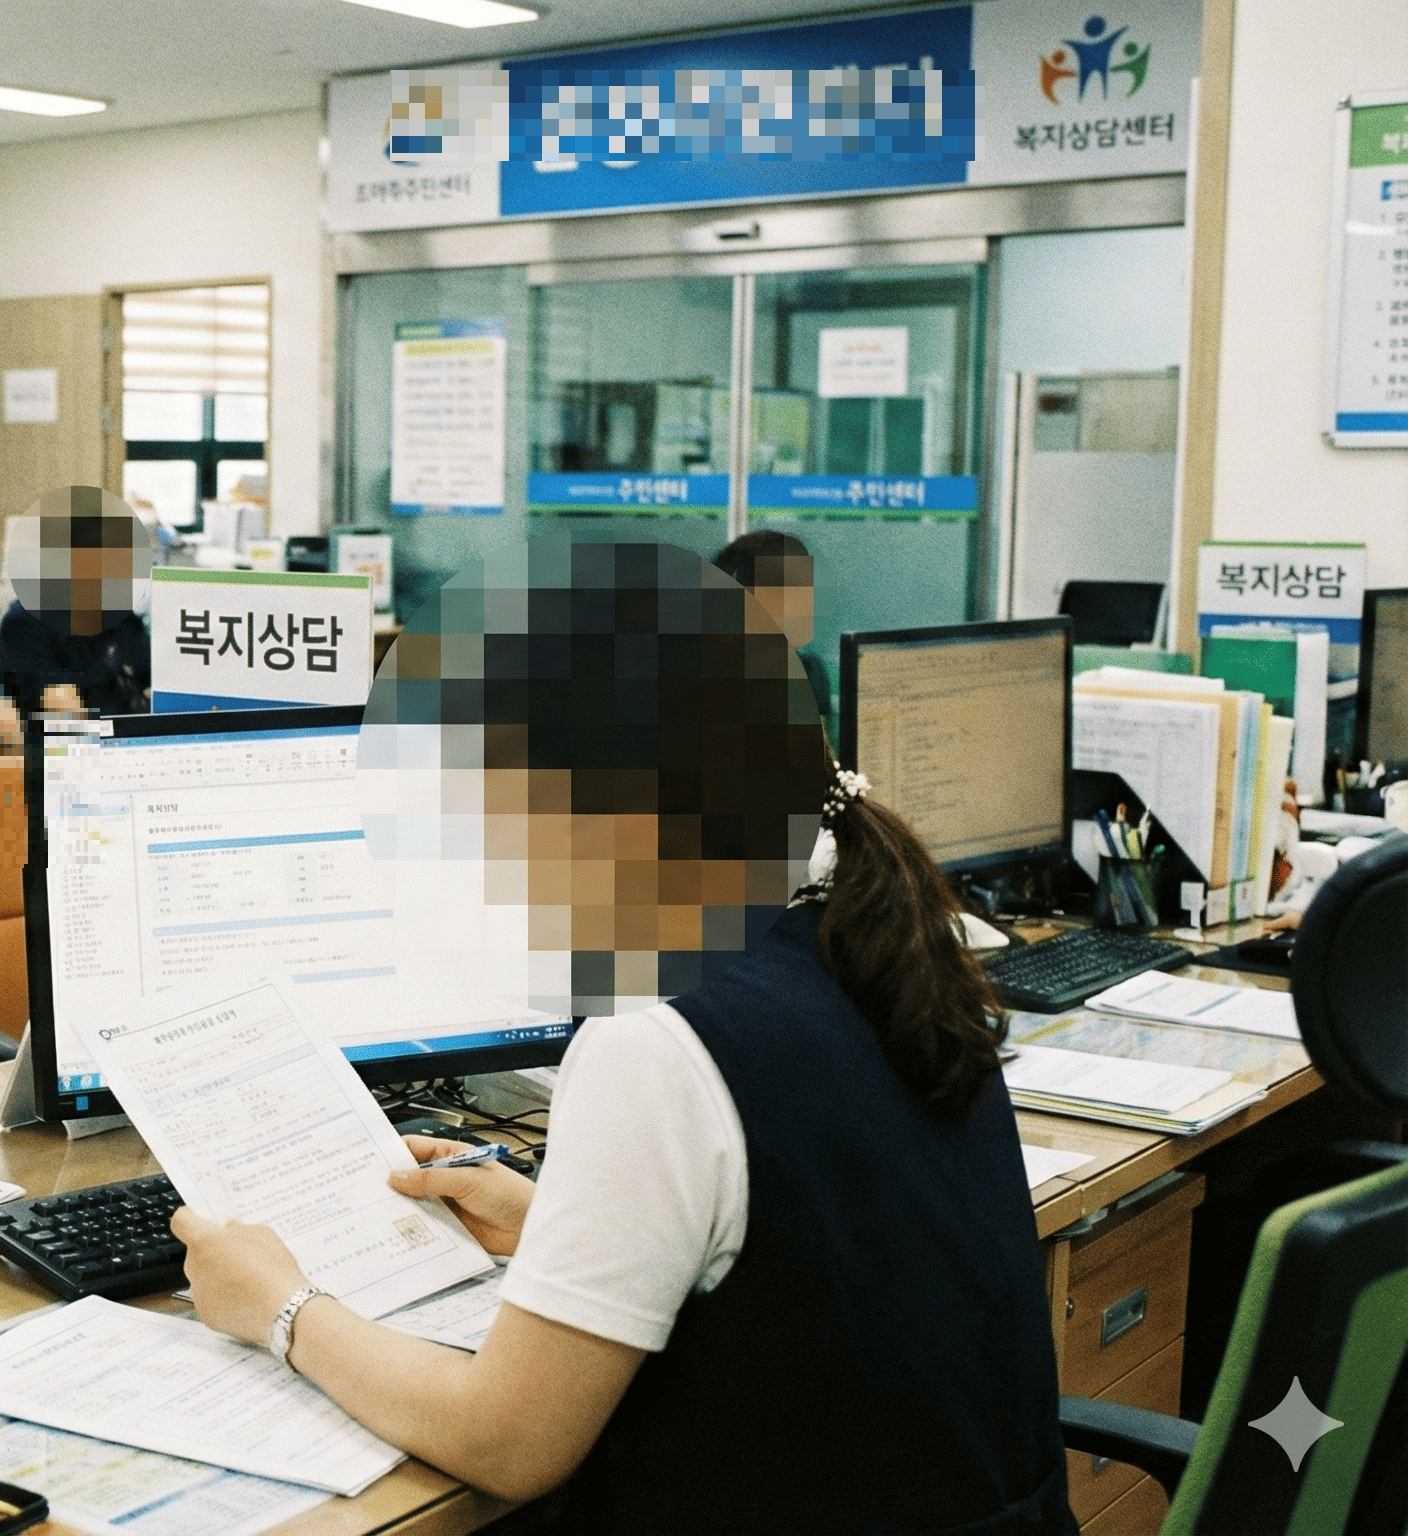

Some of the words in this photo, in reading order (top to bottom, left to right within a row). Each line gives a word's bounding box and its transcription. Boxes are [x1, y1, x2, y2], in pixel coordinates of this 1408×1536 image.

[1014, 112, 1175, 152] 복지상담센터
[1217, 563, 1346, 599] 복지상담
[175, 609, 343, 673] 복지상담
